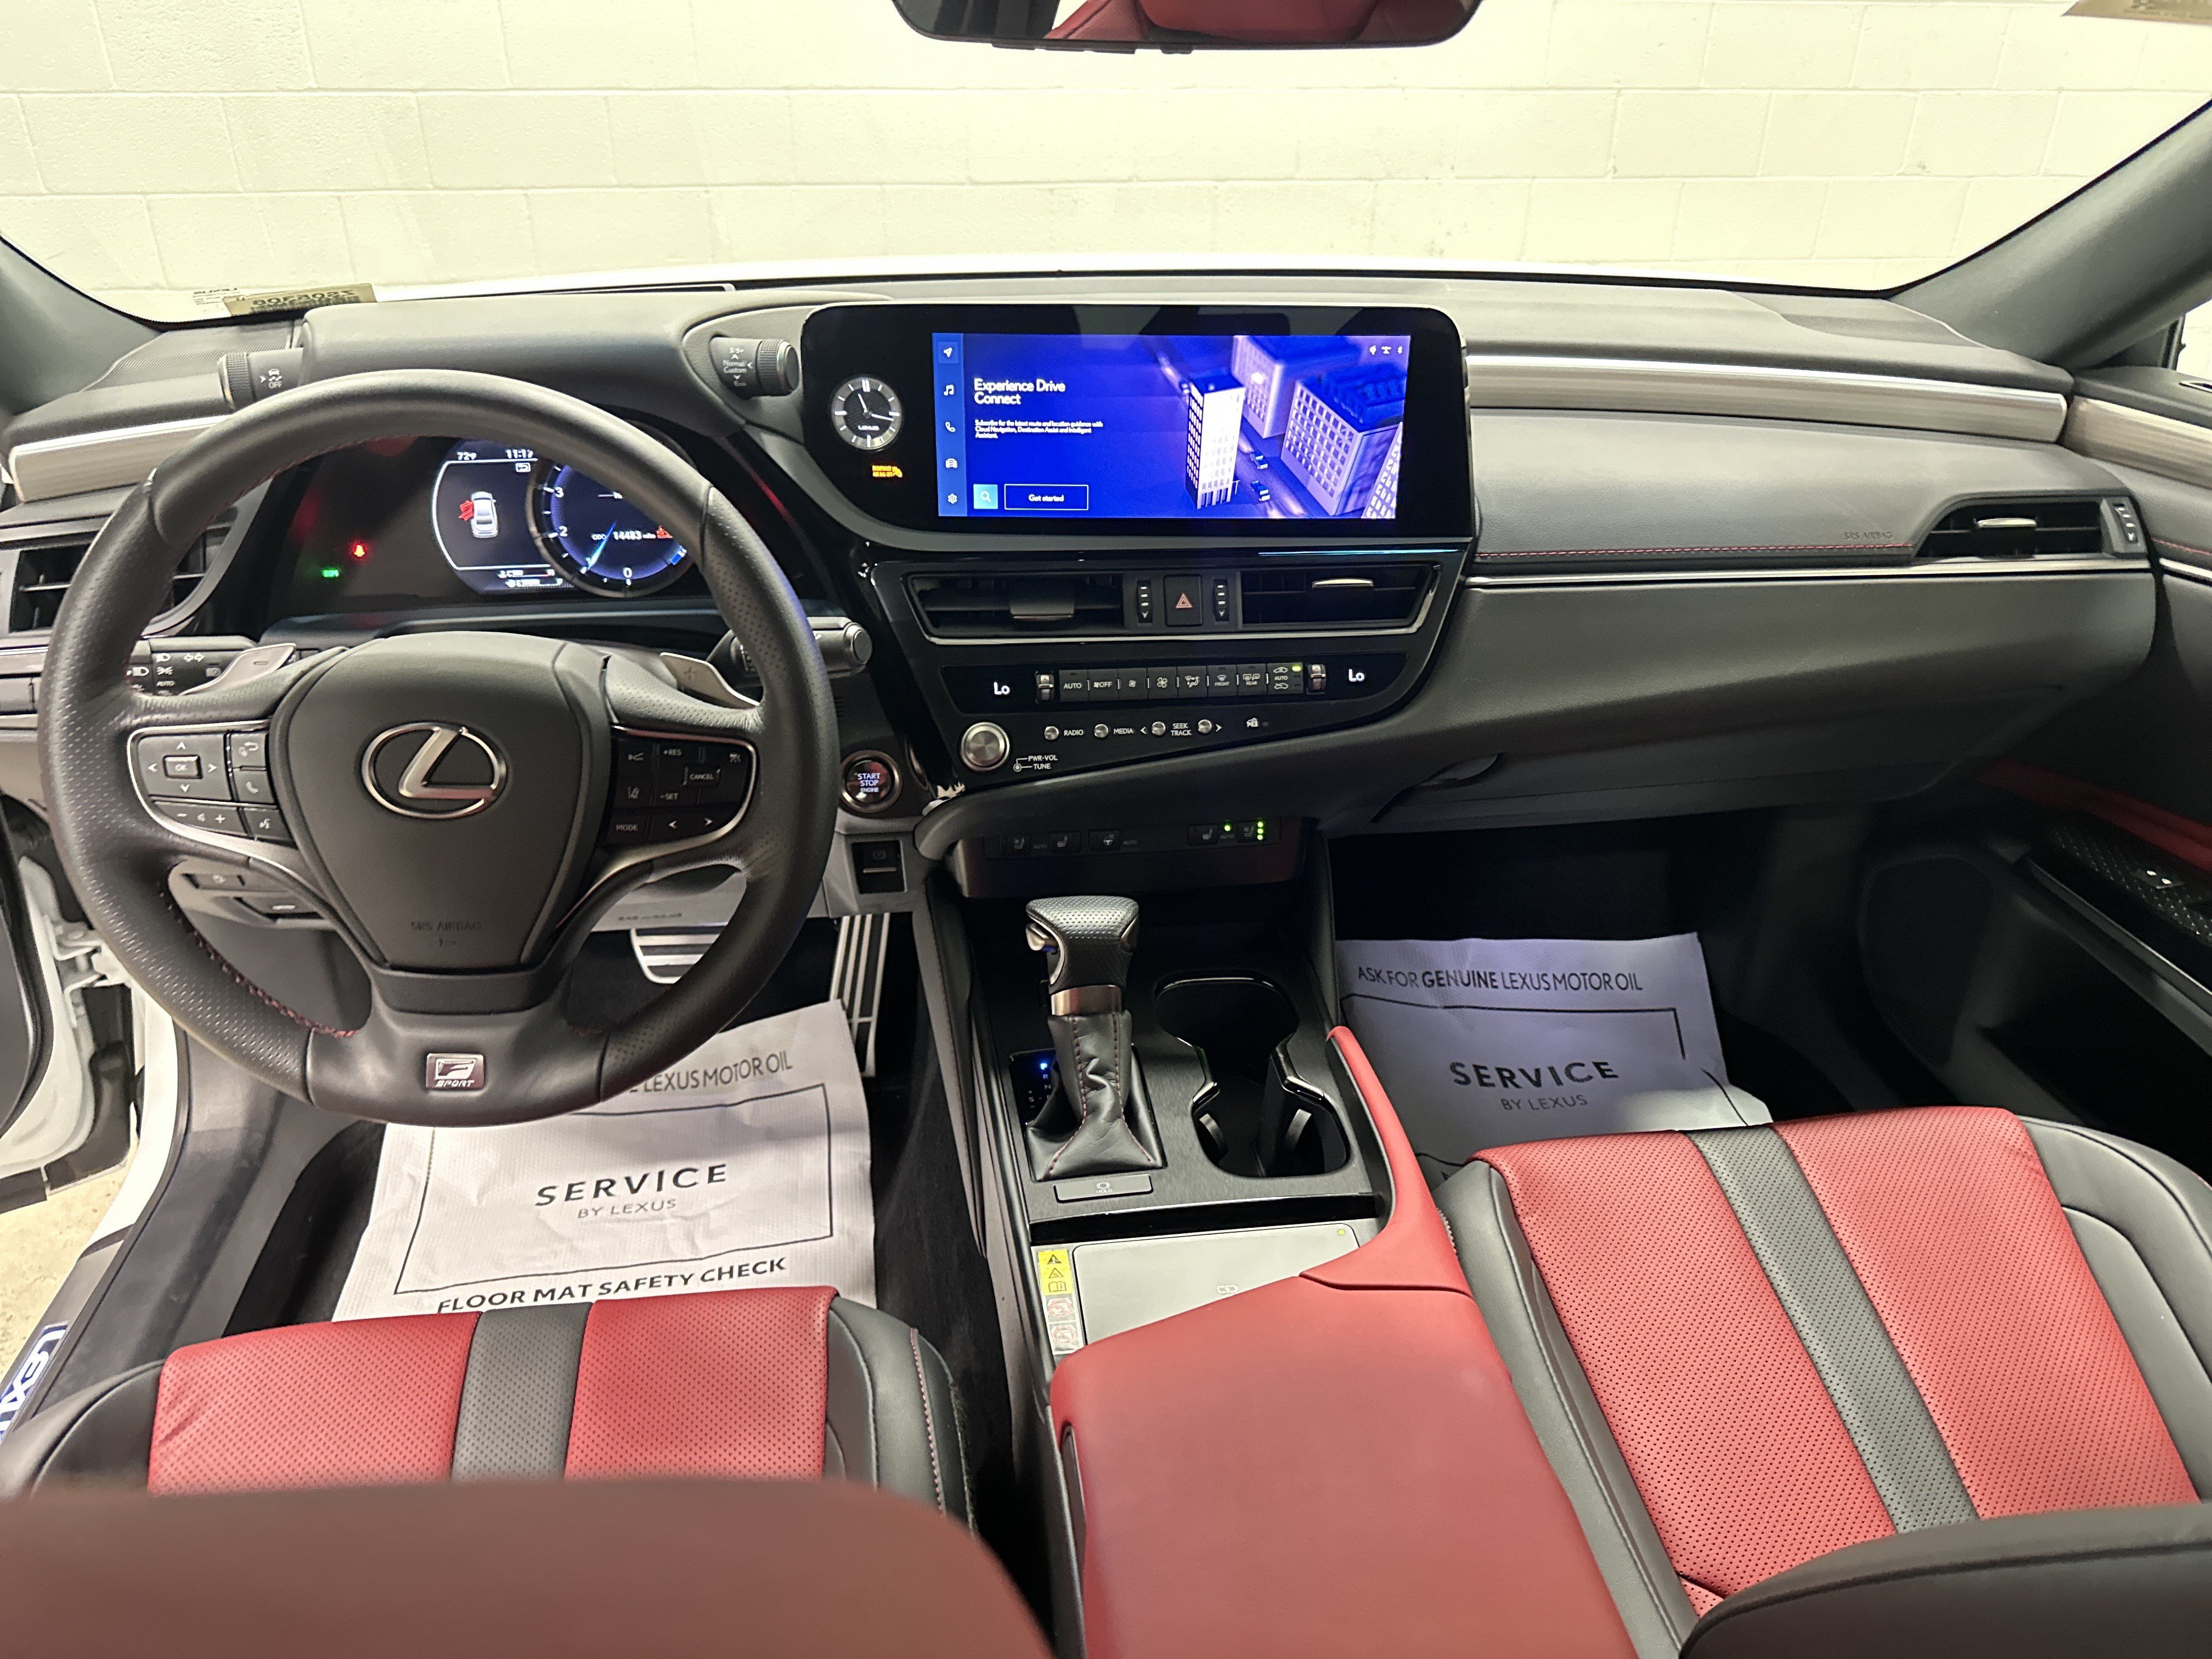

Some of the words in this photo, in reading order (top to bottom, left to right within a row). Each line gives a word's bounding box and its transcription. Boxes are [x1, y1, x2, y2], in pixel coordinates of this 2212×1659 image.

[974, 378, 1034, 393] Experience
[1036, 379, 1066, 392] Drive
[974, 392, 1022, 405] Connect
[555, 487, 564, 498] 3
[558, 526, 568, 537] 2
[623, 567, 632, 578] 0
[1348, 668, 1365, 682] Lo
[994, 681, 1011, 696] Lo
[690, 772, 713, 781] CANCEL
[616, 823, 640, 832] MODE
[1358, 966, 1387, 984] ASK
[1386, 970, 1419, 988] FOR
[1421, 969, 1499, 989] GENUINE
[1501, 971, 1551, 991] LEXUS
[1552, 972, 1614, 991] MOTOR
[1615, 972, 1643, 991] OIL
[643, 1070, 700, 1093] LEXUS
[703, 1057, 765, 1088] MOTOR
[766, 1050, 793, 1074] OIL
[1449, 1062, 1620, 1089] SERVICE
[435, 1079, 475, 1088] SPORT
[1500, 1098, 1522, 1111] BY
[1528, 1094, 1588, 1111] LEXUS
[535, 1164, 727, 1206] SERVICE
[578, 1206, 603, 1219] BY
[611, 1198, 677, 1215] LEXUS
[437, 1290, 526, 1314] FLOOR
[533, 1283, 593, 1303] MAT
[598, 1272, 696, 1296] SAFETY
[700, 1256, 787, 1283] CHECK
